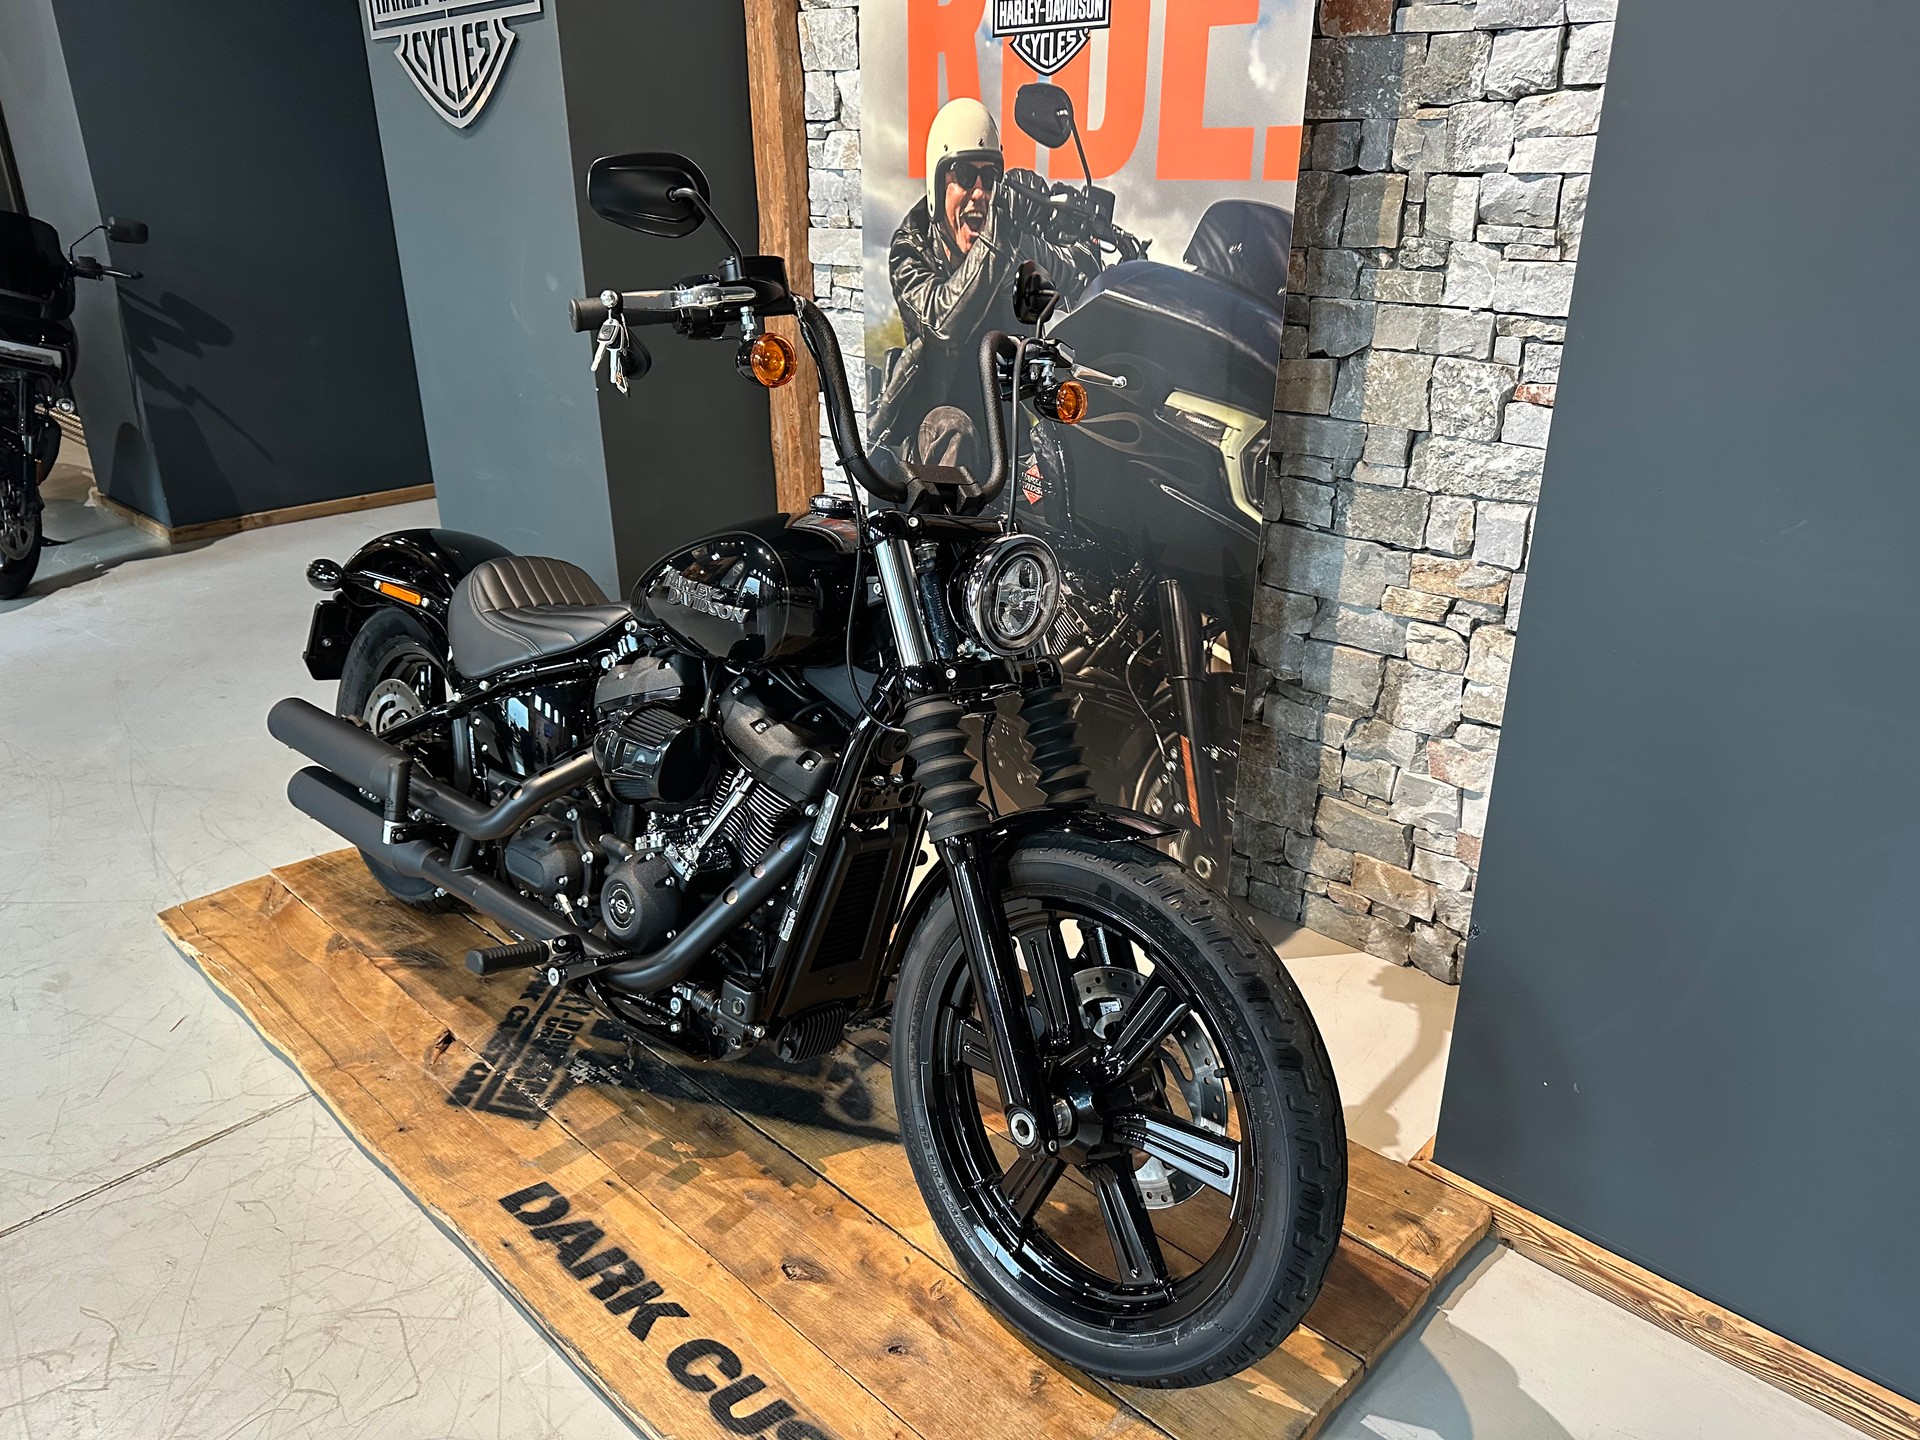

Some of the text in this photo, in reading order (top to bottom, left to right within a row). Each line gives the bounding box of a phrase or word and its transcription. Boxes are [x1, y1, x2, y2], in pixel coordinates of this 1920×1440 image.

[998, 0, 1104, 27] HARLEY-DAVIDSON
[412, 20, 491, 104] CYCLES
[1021, 29, 1077, 67] CYCLES
[666, 586, 750, 624] DAVIDSON
[499, 1181, 690, 1342] DARK
